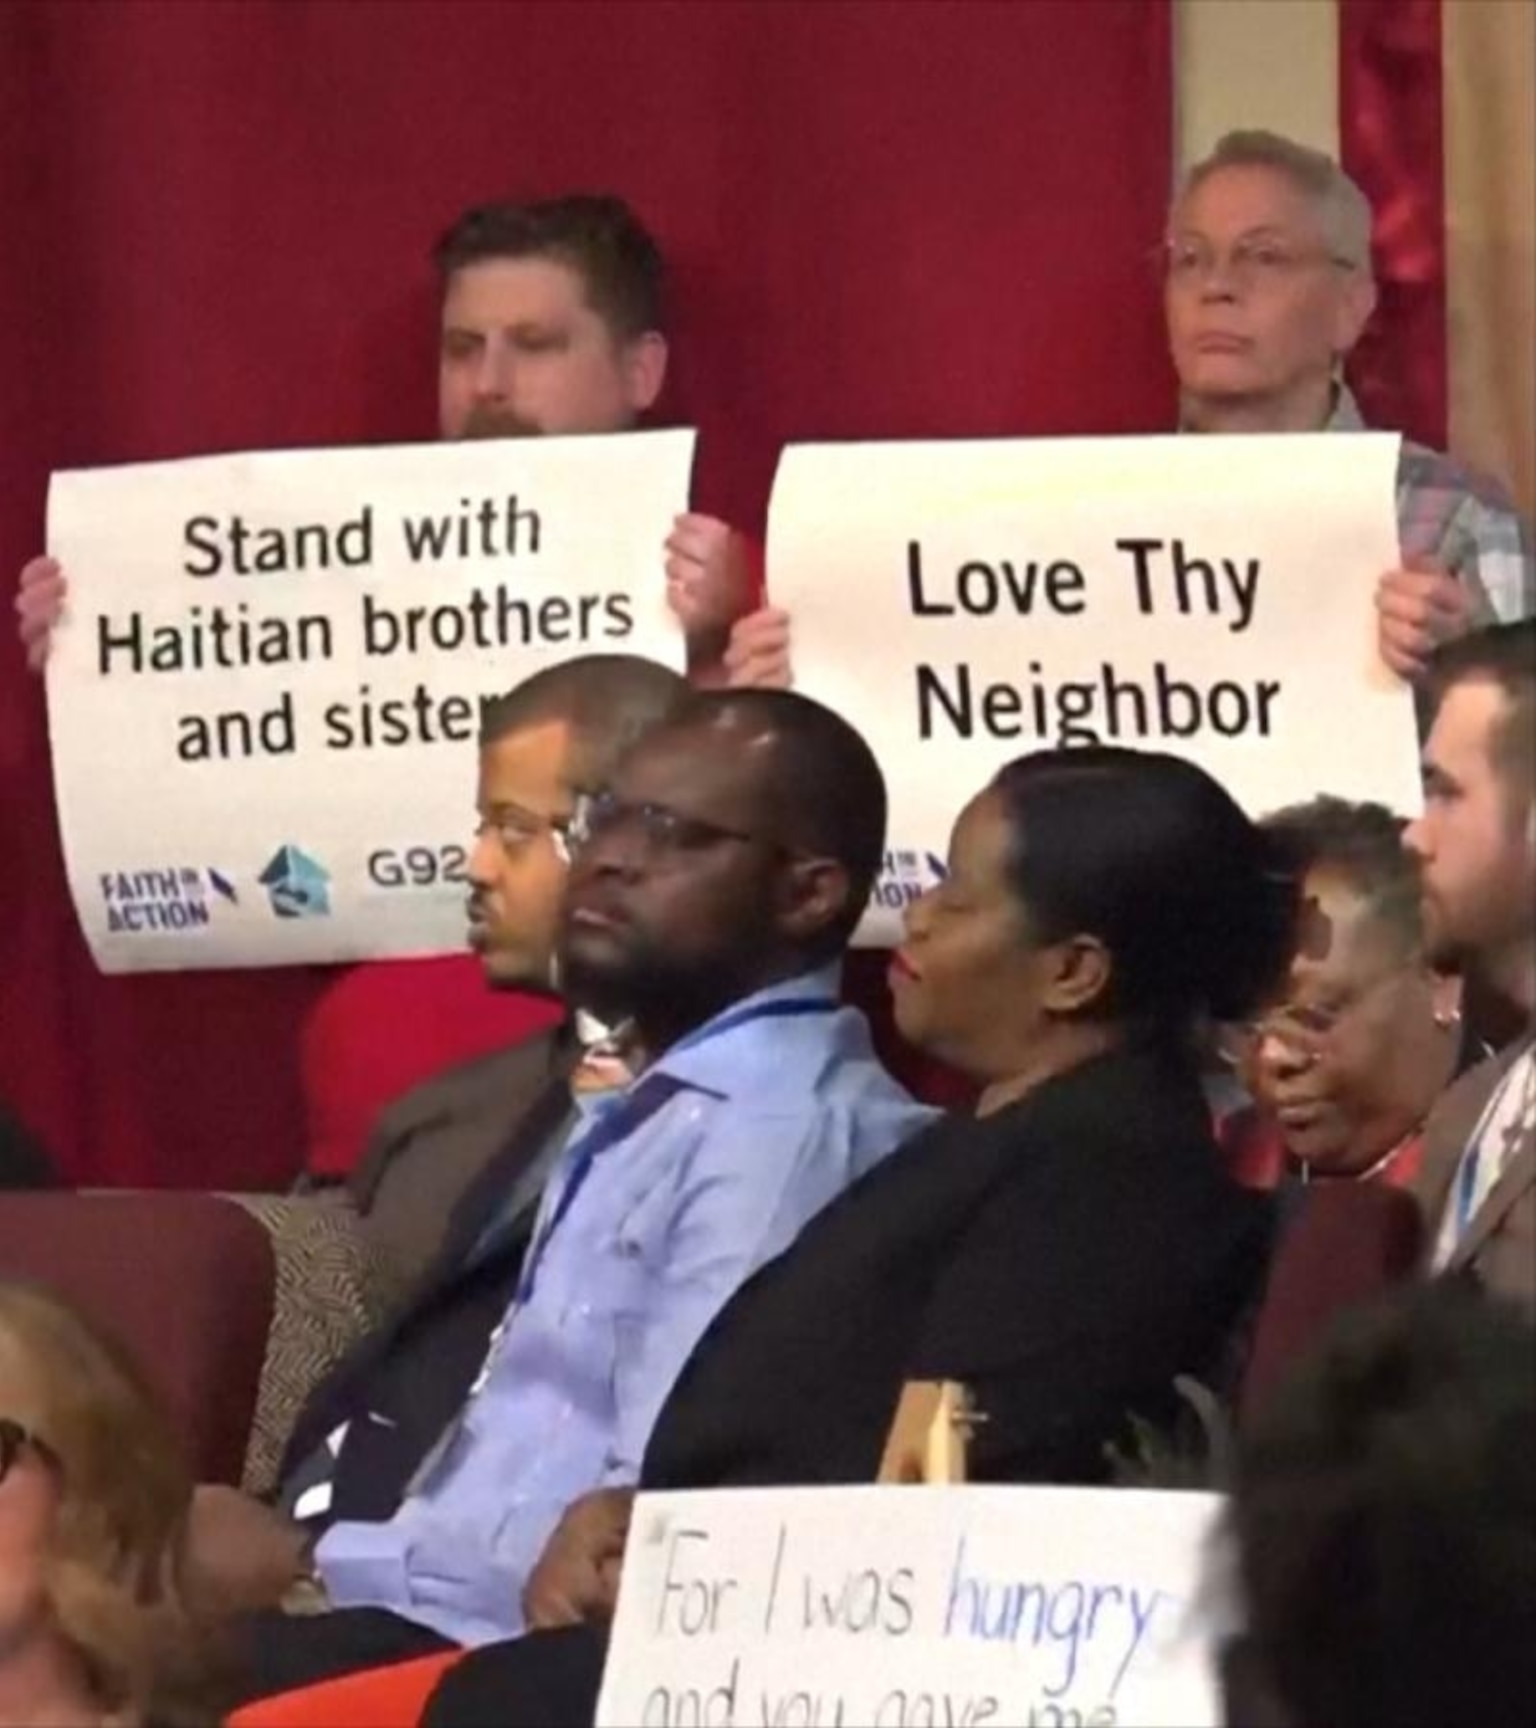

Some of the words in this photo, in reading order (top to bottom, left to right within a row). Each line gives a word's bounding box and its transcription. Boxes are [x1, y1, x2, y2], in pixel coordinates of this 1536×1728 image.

[183, 505, 373, 579] Stand
[402, 494, 542, 562] with
[907, 540, 1087, 618] Love
[1115, 538, 1261, 634] Thy
[97, 602, 333, 676] Haitian
[362, 583, 634, 658] brothers
[176, 691, 296, 762] and
[323, 683, 500, 750] siste
[915, 661, 1282, 749] Neighbor
[99, 866, 180, 901] FAITH
[367, 844, 470, 888] G92
[106, 900, 210, 932] ACTION
[801, 1565, 915, 1637] was
[943, 1532, 1164, 1699] hungry
[642, 1656, 741, 1728] and
